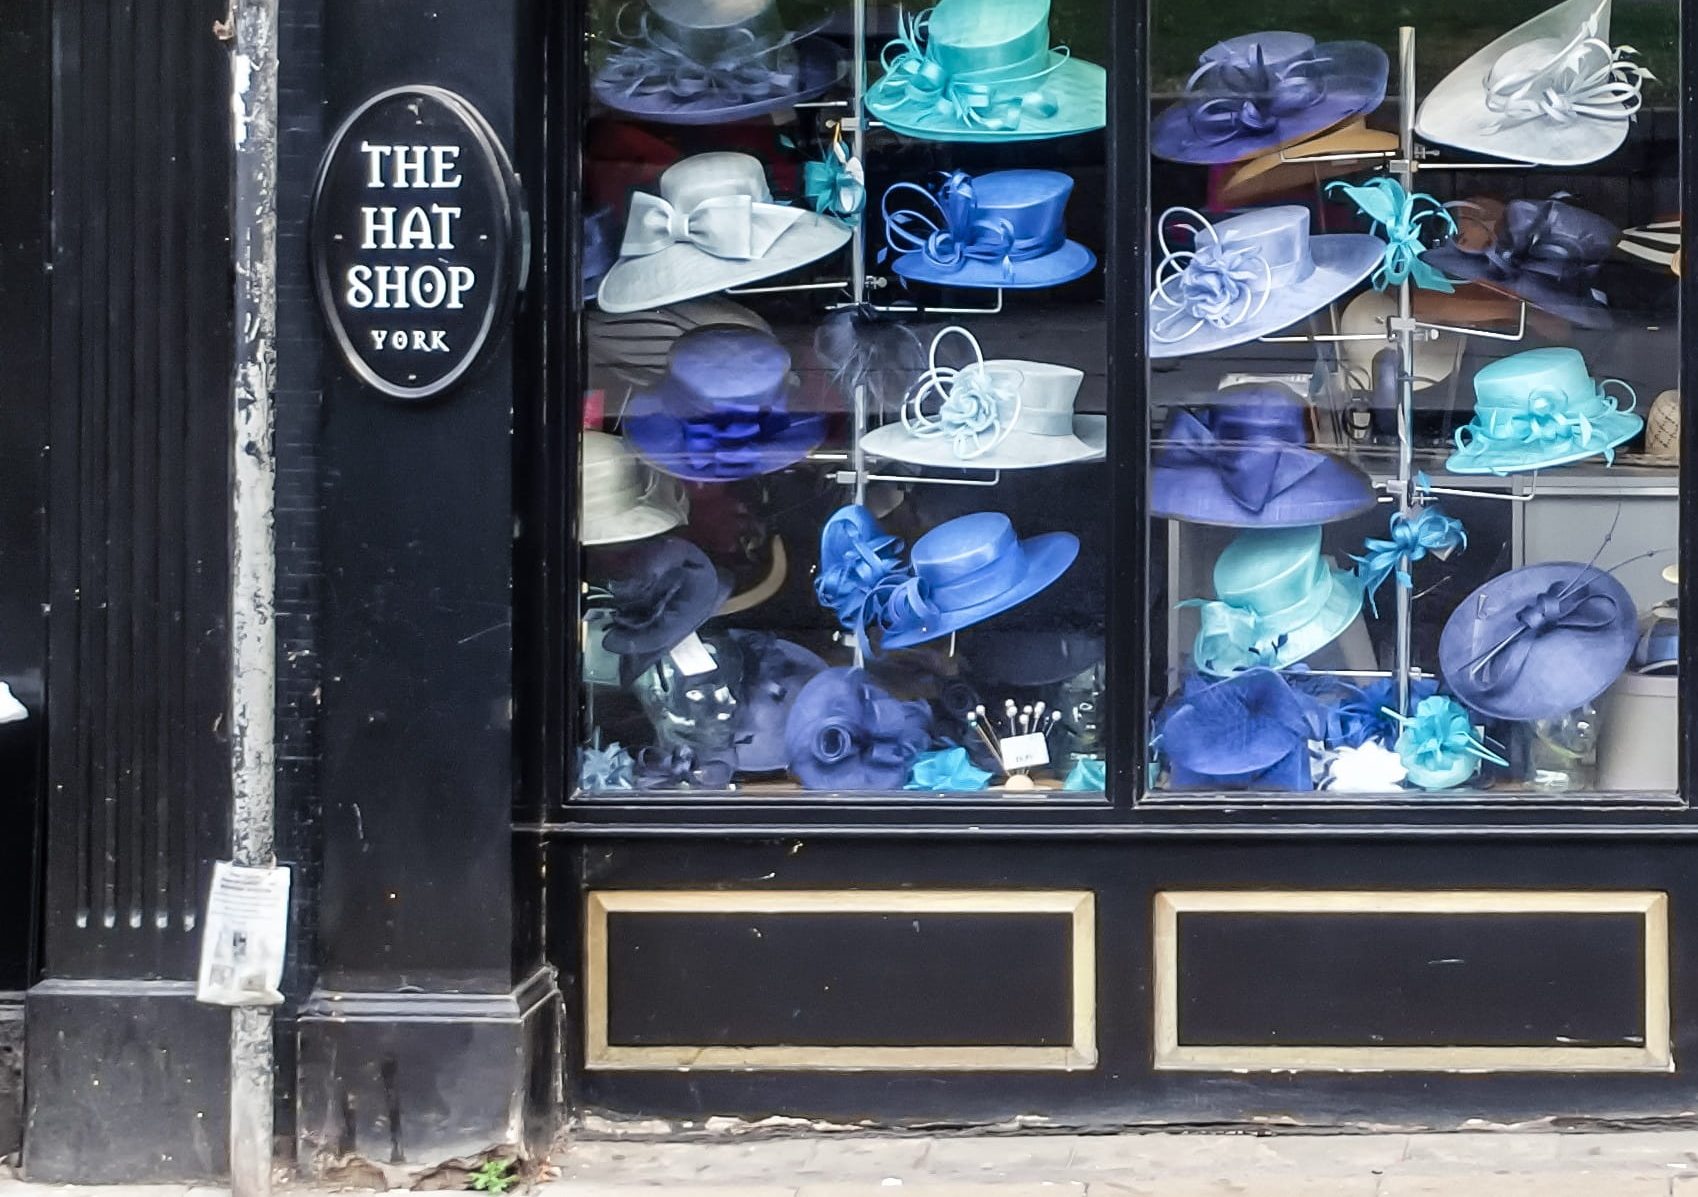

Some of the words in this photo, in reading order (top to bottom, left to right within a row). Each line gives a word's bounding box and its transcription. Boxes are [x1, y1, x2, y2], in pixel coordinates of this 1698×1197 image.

[360, 140, 462, 188] THE
[360, 203, 462, 250] HAT
[345, 264, 475, 309] SHOP
[370, 329, 450, 353] YORK
